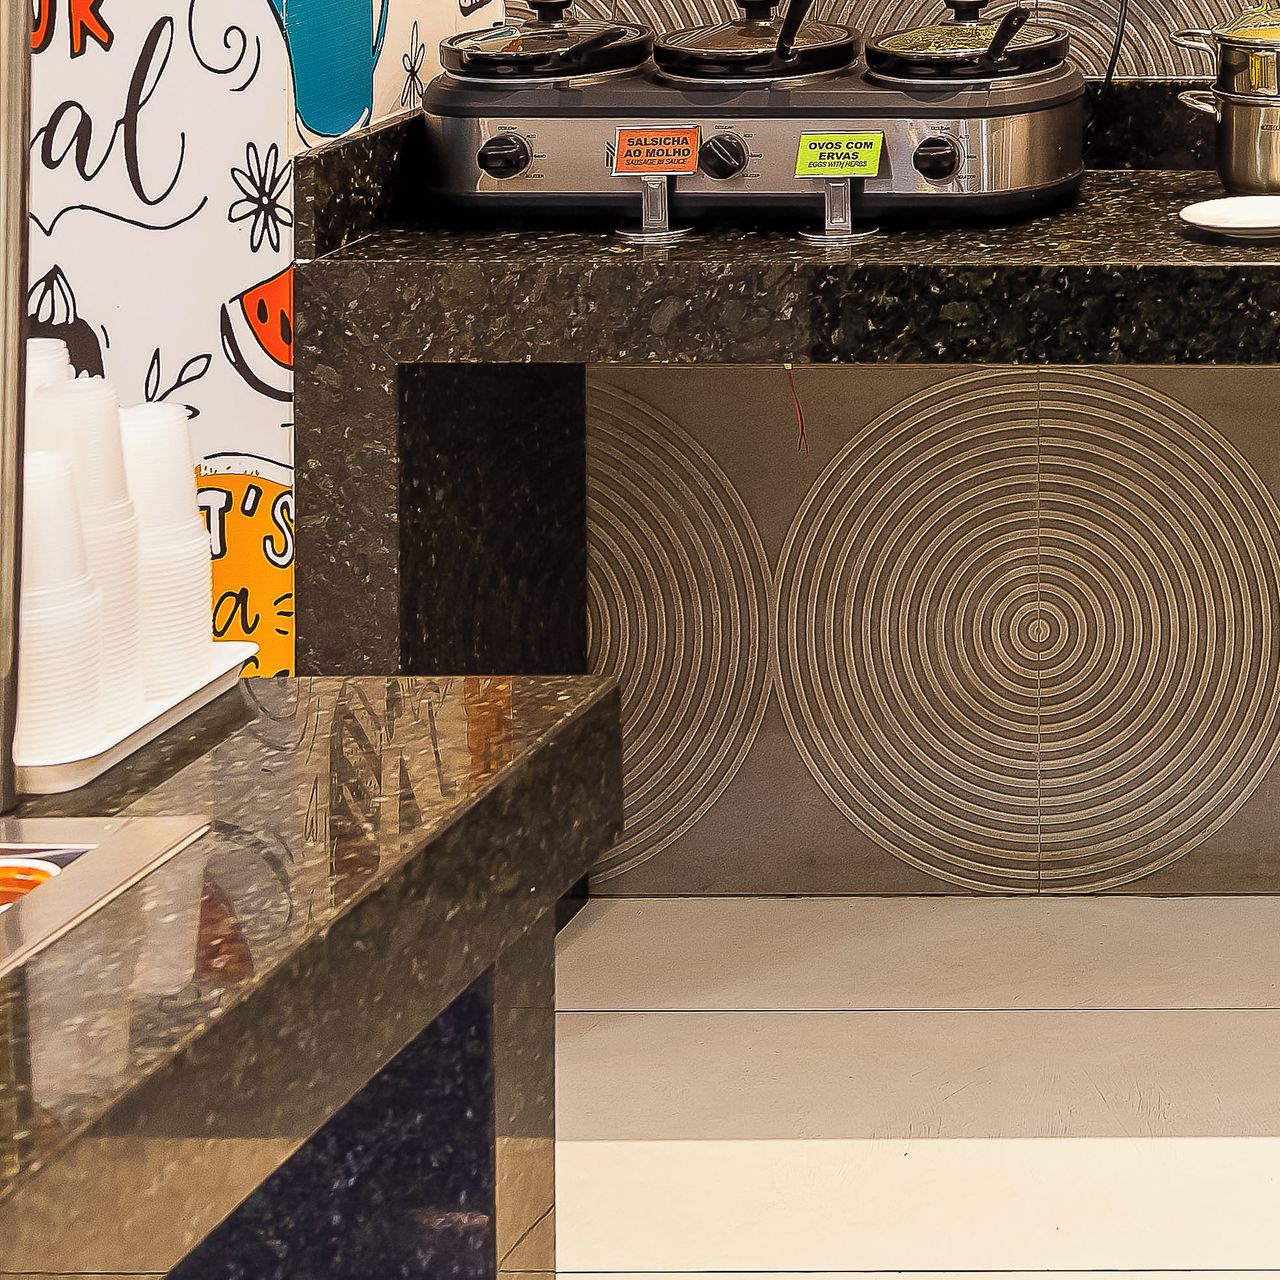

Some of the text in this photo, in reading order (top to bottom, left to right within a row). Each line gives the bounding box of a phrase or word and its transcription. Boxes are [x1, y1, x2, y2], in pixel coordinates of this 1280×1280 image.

[29, 15, 186, 207] al
[627, 137, 689, 146] SALSICHA
[808, 141, 873, 150] OVOS COM
[624, 148, 691, 158] AO MOLHO
[818, 152, 859, 160] ERVAS
[197, 484, 295, 568] T'S
[212, 587, 260, 637] a
